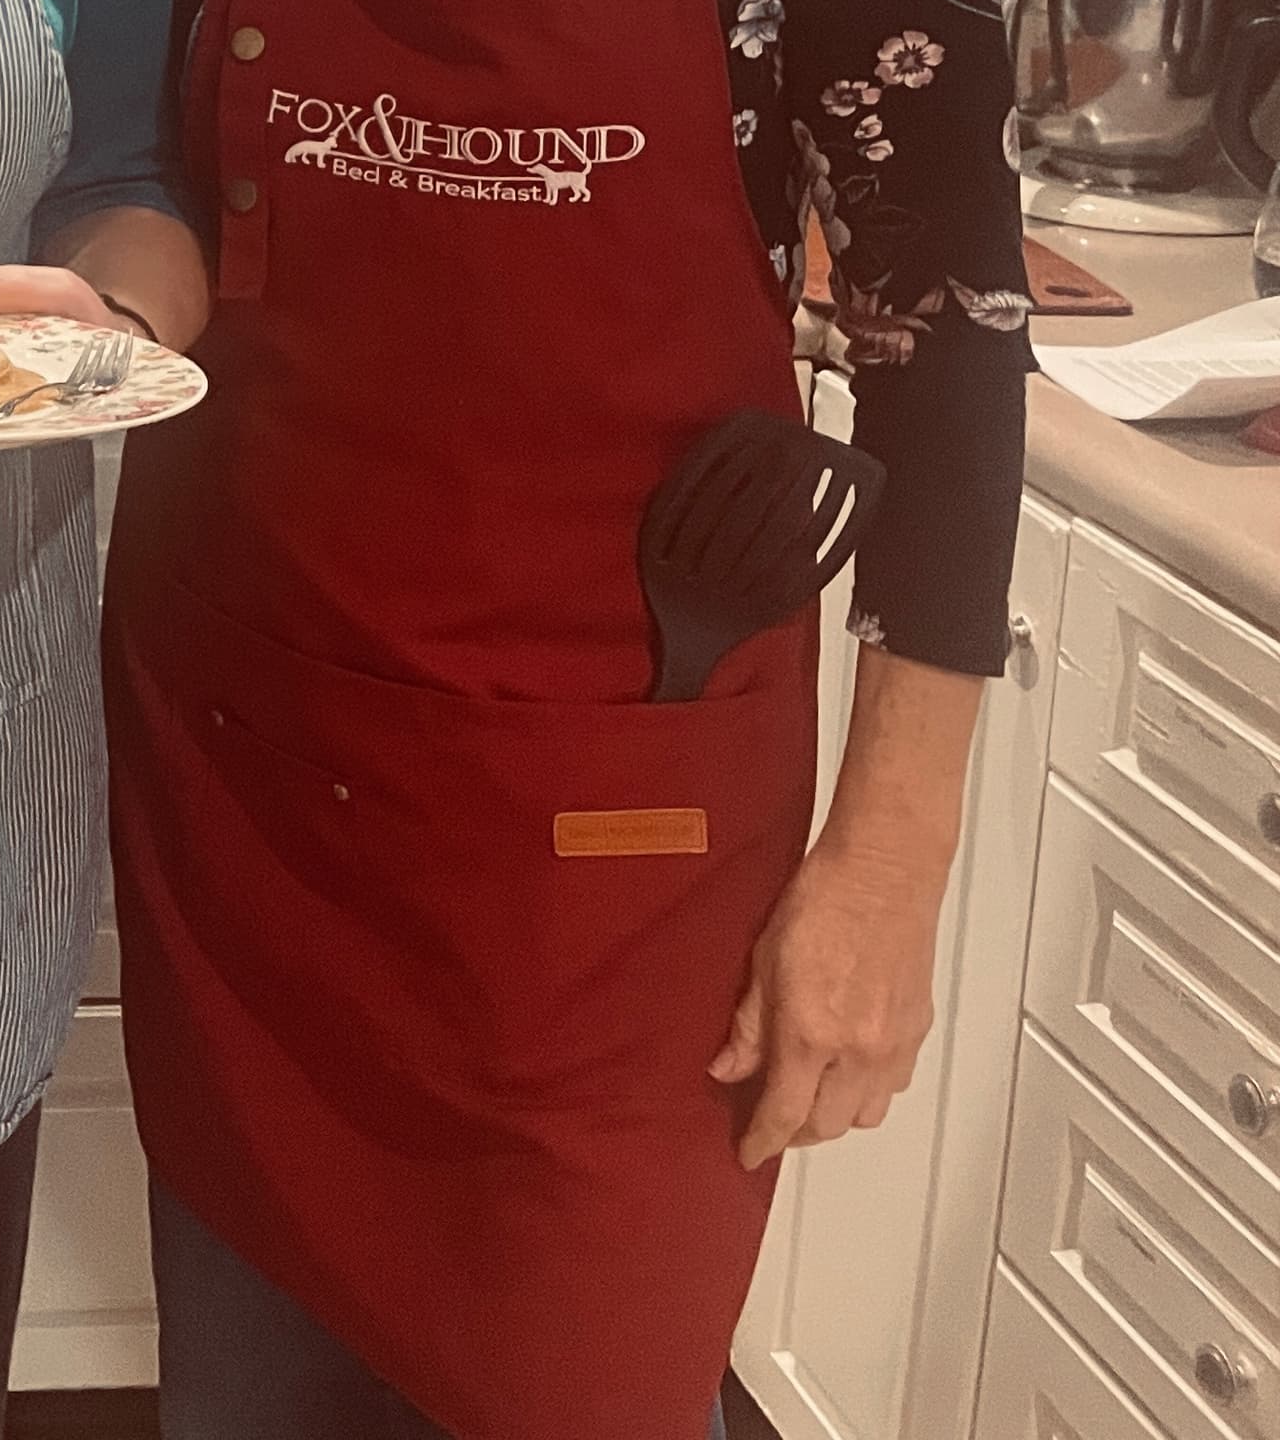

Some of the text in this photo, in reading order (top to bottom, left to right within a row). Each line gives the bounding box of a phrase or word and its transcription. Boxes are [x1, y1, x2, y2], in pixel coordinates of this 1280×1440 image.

[332, 158, 543, 202] Bed & Breakfast
